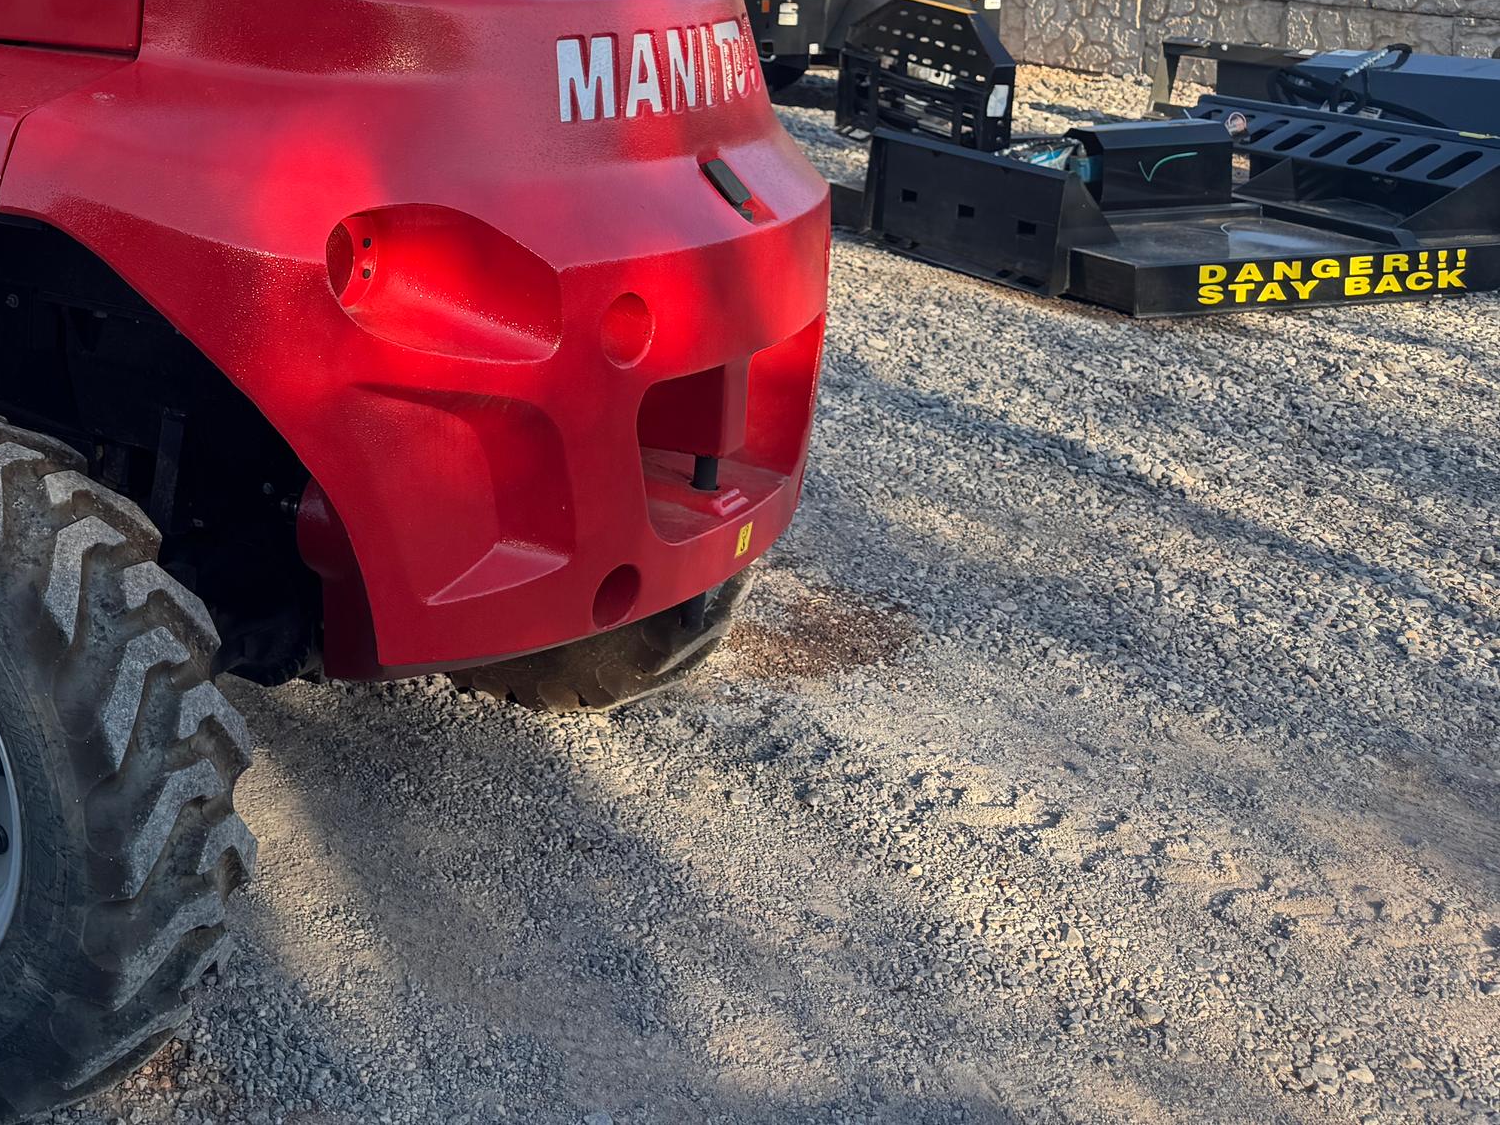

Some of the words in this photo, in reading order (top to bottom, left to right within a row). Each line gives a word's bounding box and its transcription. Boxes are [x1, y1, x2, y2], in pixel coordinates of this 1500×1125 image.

[1199, 249, 1467, 284] DANGER!!!
[1197, 279, 1320, 305] STAY
[1344, 268, 1468, 296] BACK
